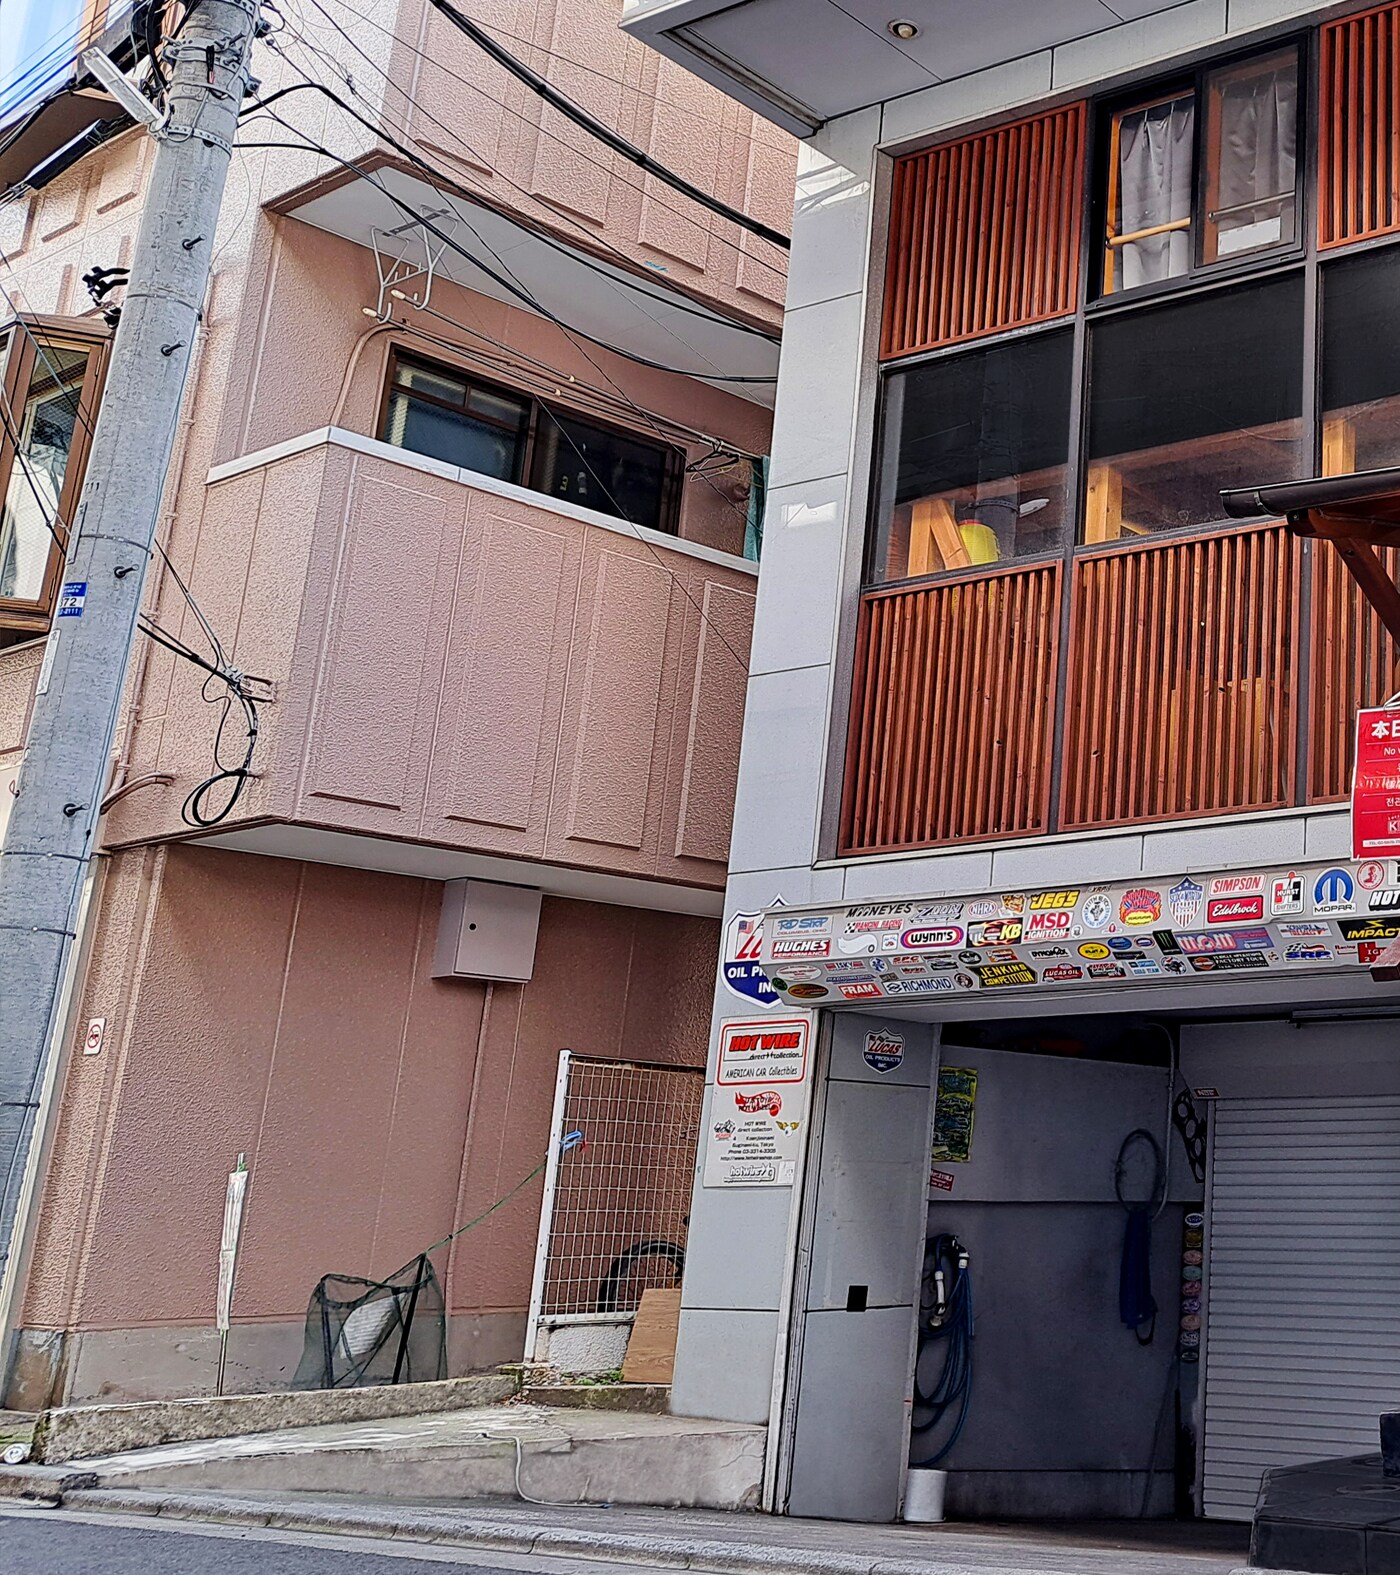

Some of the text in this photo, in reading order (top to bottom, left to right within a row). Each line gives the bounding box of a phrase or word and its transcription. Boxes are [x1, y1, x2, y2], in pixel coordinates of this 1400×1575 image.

[1384, 747, 1396, 756] No
[1213, 876, 1261, 894] SIMPSON
[1030, 890, 1080, 910] JEG'S
[1277, 888, 1300, 898] HURST
[846, 902, 914, 918] MOONEYES
[969, 903, 994, 915] NHRA
[1212, 901, 1258, 917] Edelbrock
[1314, 903, 1354, 913] MOPAR
[1029, 912, 1071, 930] MSD
[1000, 923, 1023, 940] KB
[1027, 928, 1067, 940] IGNITION
[774, 939, 830, 953] HUGHES
[773, 951, 828, 959] PERFORMANCE
[727, 966, 748, 979] OIL
[983, 971, 1035, 987] COMPETITION
[1045, 969, 1067, 977] LUCAS
[1067, 968, 1080, 976] OIL
[841, 985, 875, 995] FRAM
[901, 978, 952, 992] RICHMOND
[729, 1031, 801, 1052] HOT WIRE
[868, 1041, 902, 1054] LUCAS
[725, 1064, 798, 1079] AMERICAN CAR Collectibles
